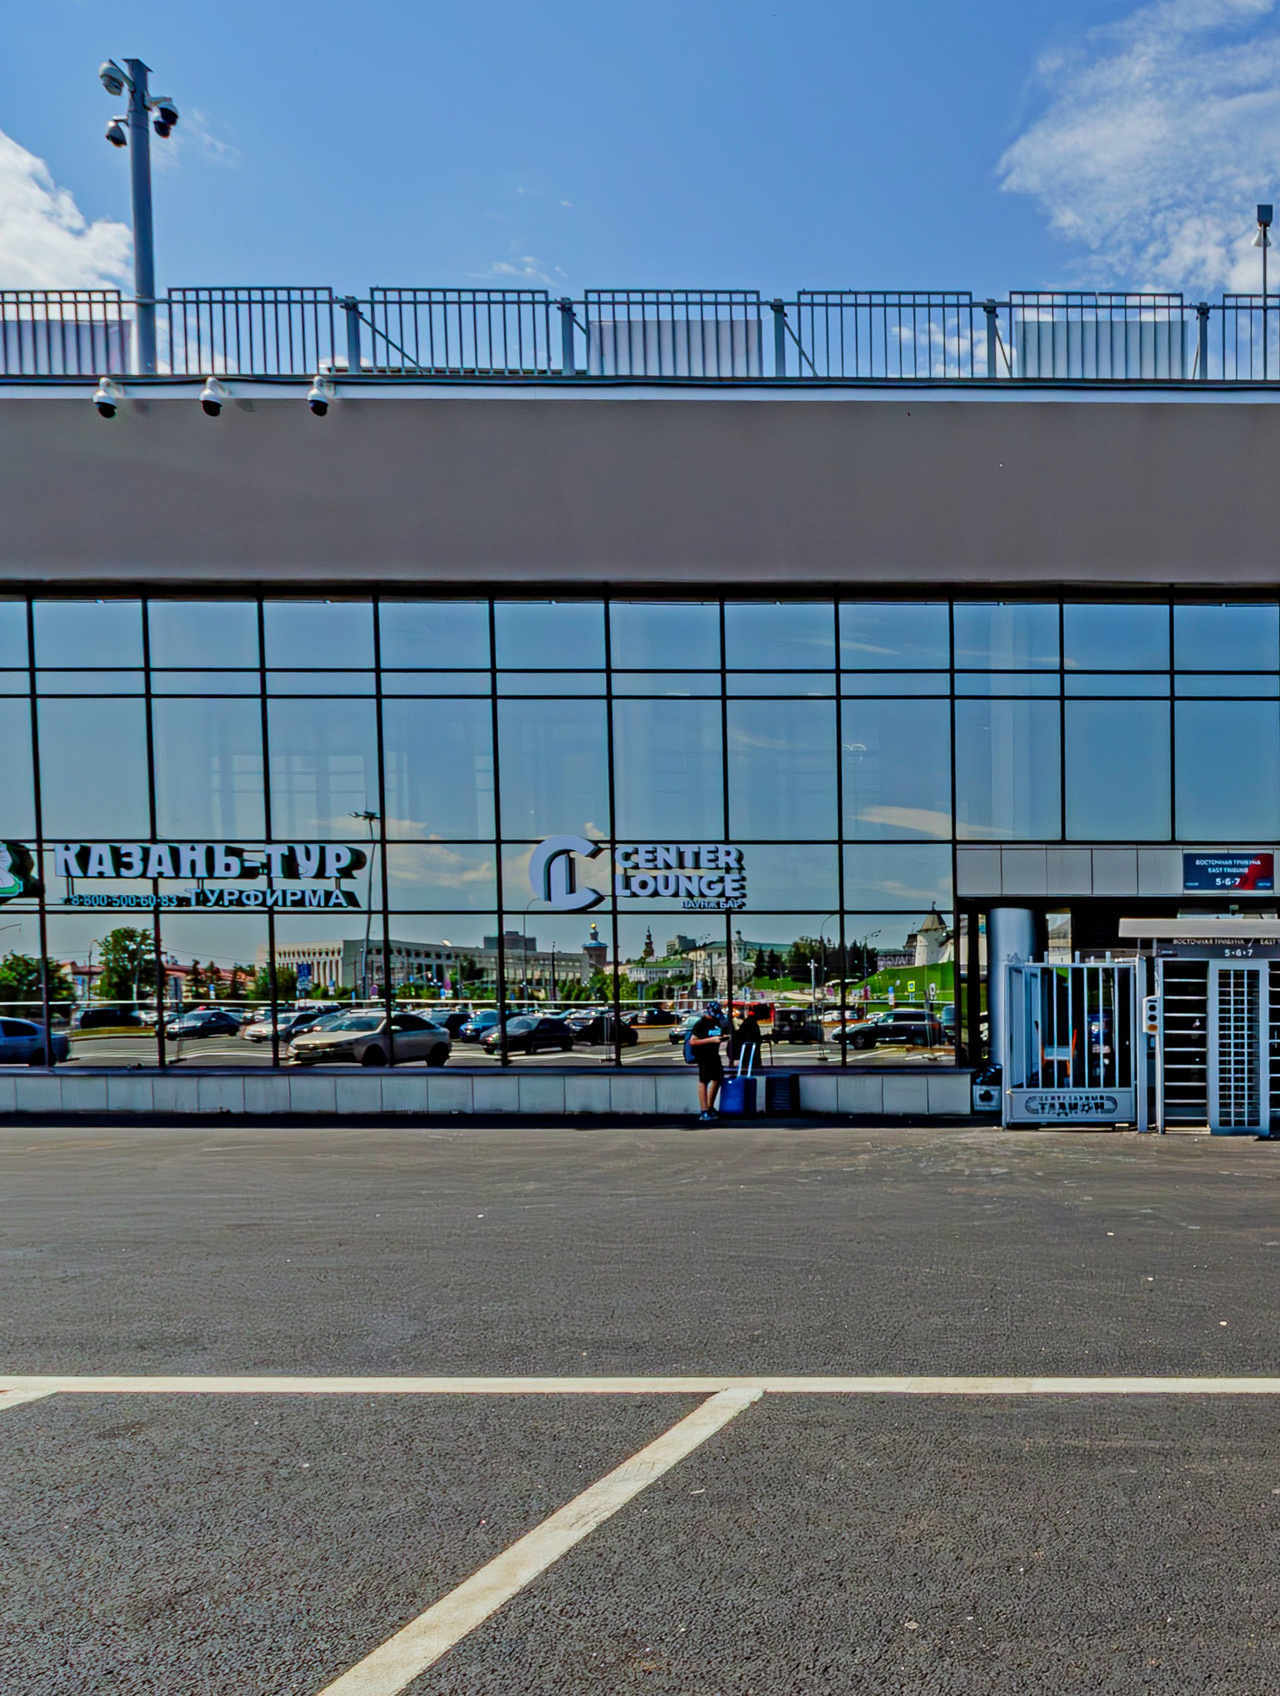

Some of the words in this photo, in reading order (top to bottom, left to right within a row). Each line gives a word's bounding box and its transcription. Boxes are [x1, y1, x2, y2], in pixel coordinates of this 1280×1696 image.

[54, 844, 353, 878] КАЗАНЬ-ТУР
[615, 845, 740, 869] CENTER
[615, 874, 742, 897] LOUNGE
[184, 888, 349, 908] ТУРФИРМА
[719, 899, 743, 909] БАР
